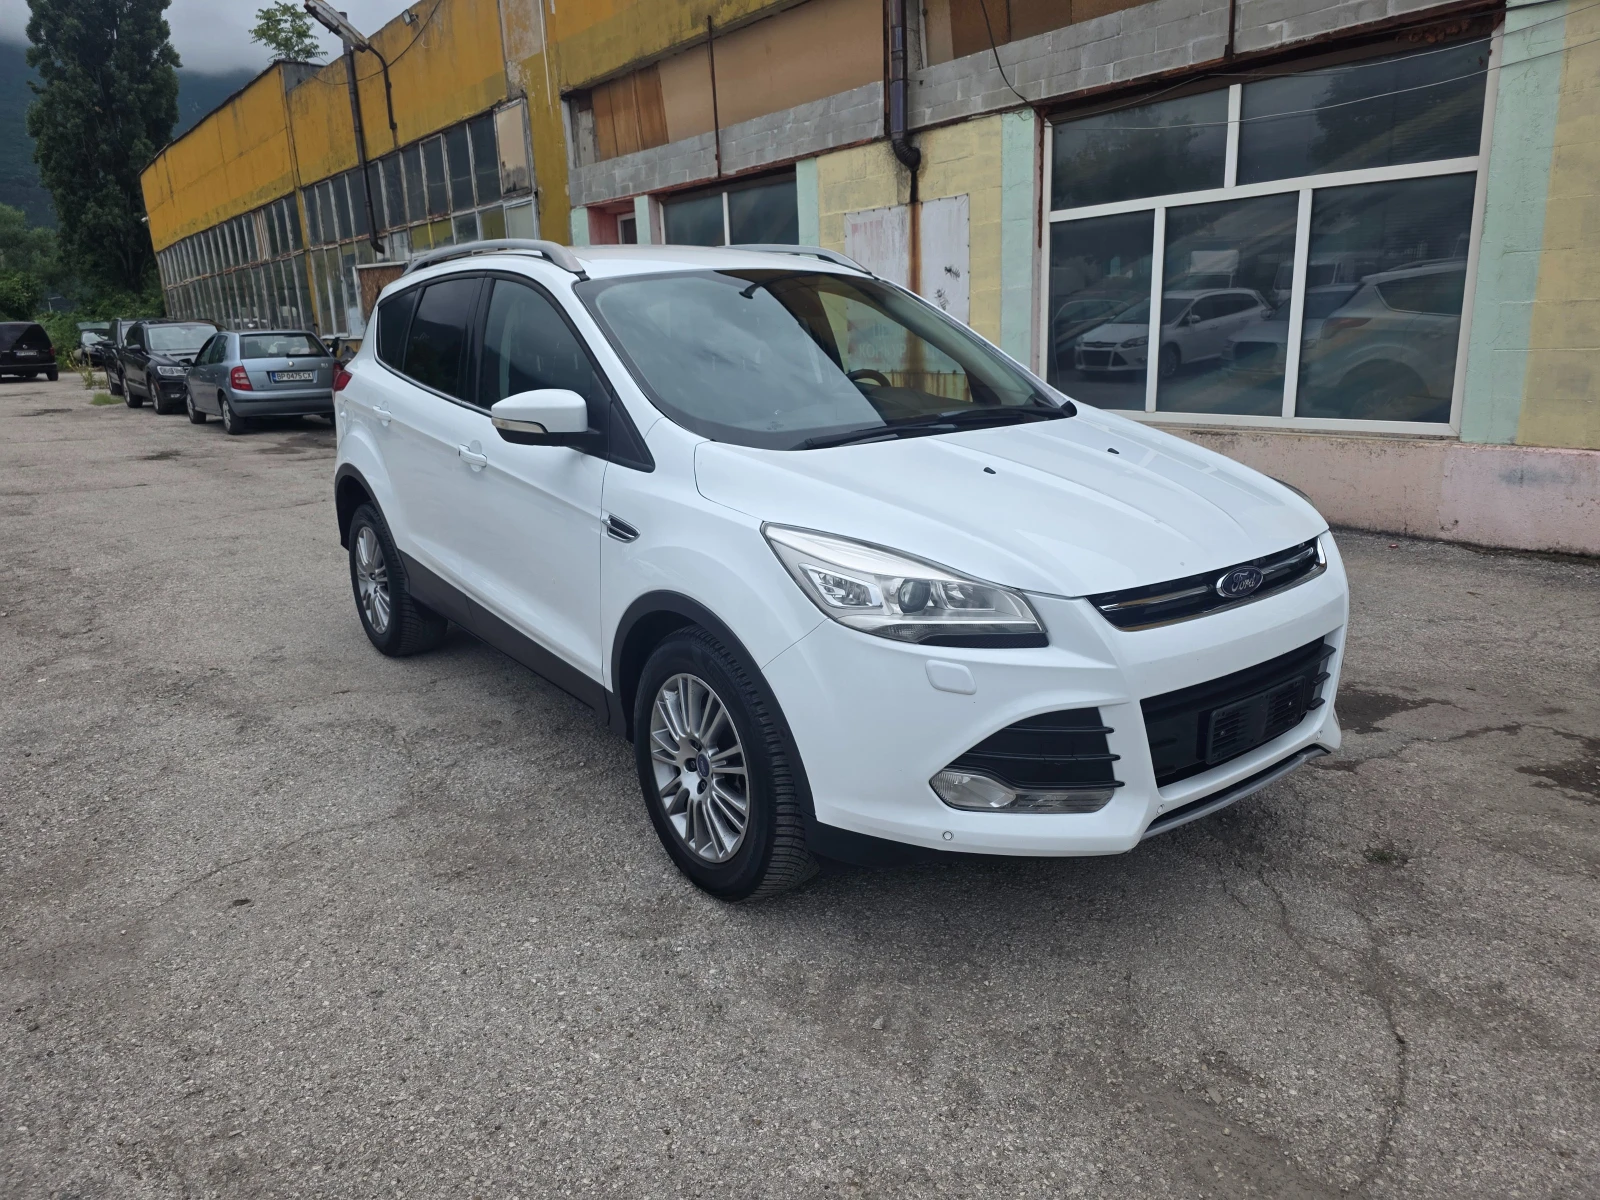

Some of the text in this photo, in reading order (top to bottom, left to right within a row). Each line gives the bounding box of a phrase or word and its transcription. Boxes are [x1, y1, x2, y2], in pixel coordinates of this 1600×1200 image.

[276, 371, 312, 380] BP 0475 CX
[1231, 571, 1257, 593] Ford
